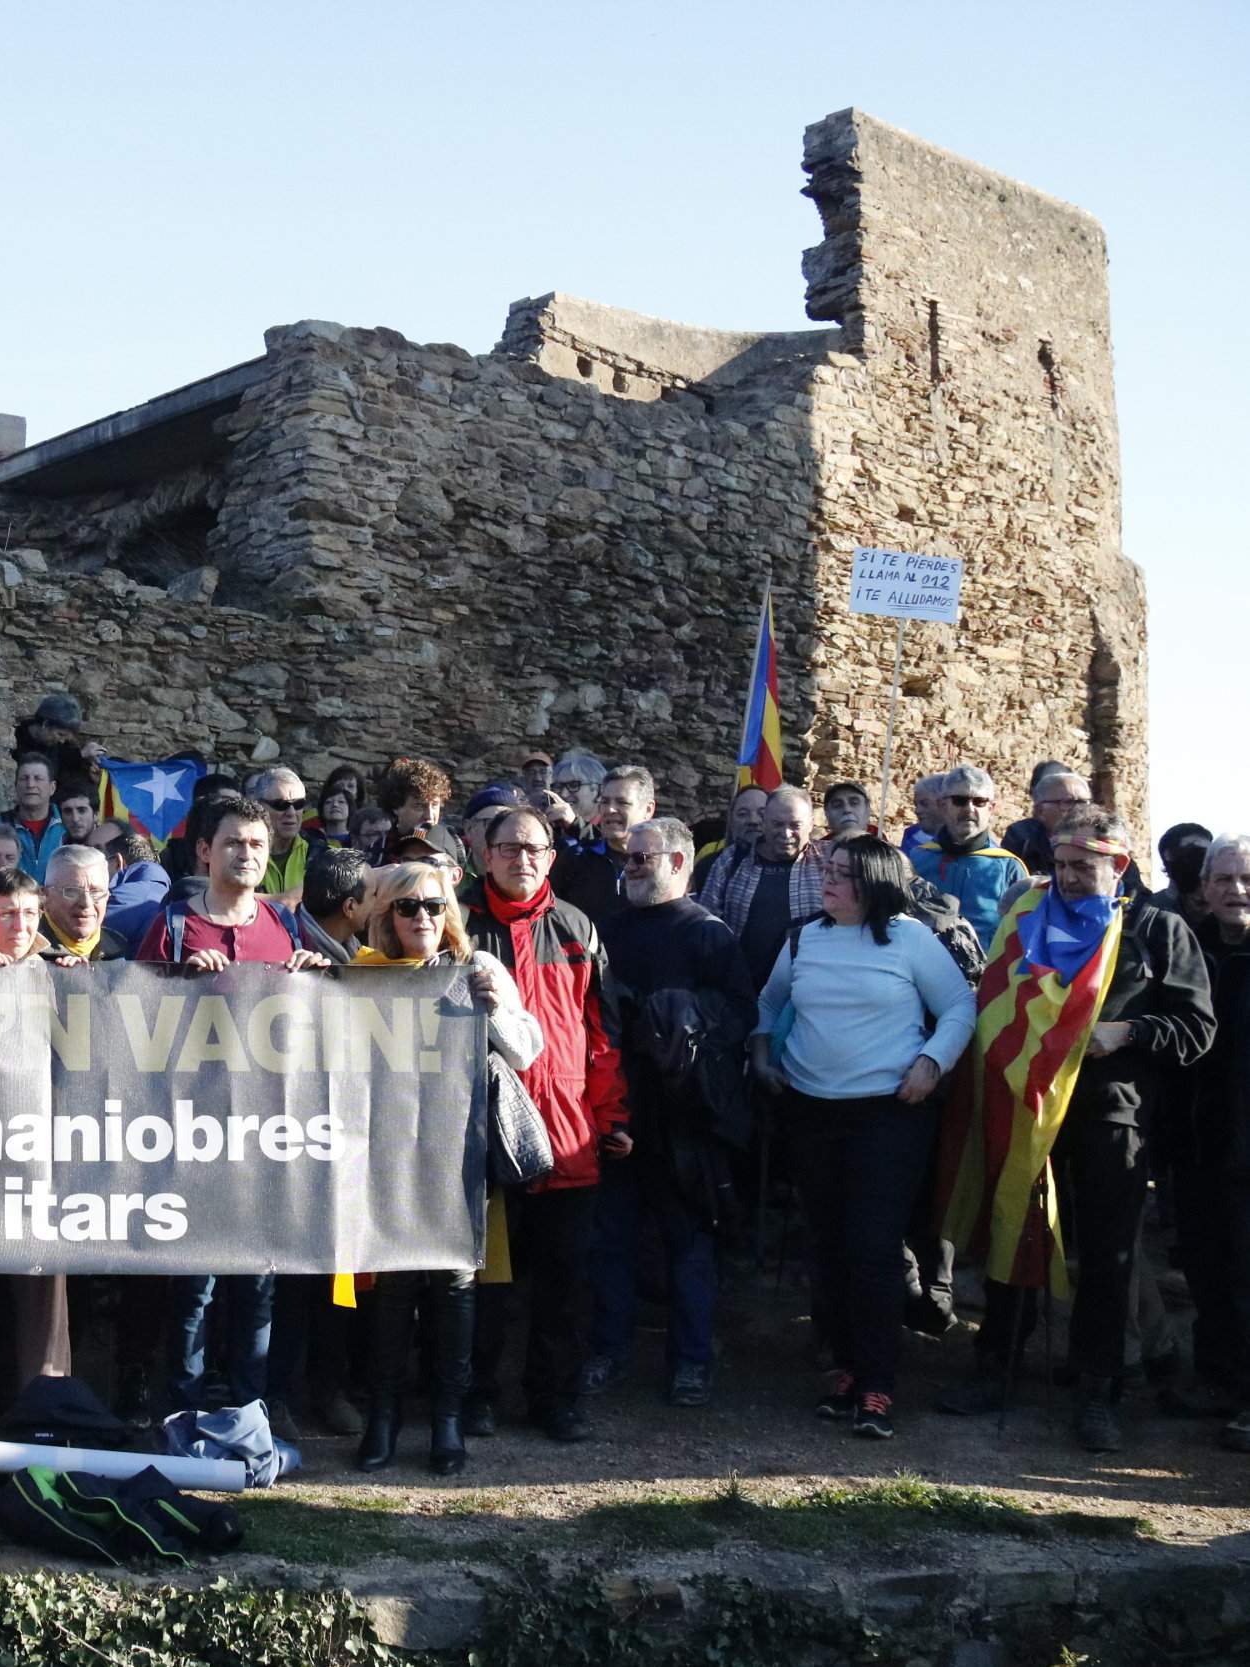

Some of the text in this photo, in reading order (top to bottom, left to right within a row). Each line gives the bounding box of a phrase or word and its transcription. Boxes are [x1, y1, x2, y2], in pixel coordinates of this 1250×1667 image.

[882, 553, 899, 566] TE
[859, 569, 950, 589] LLAMA AL 012
[865, 589, 882, 601] TE
[887, 591, 954, 607] ALLUDAMOS
[117, 993, 442, 1073] VAGIN!
